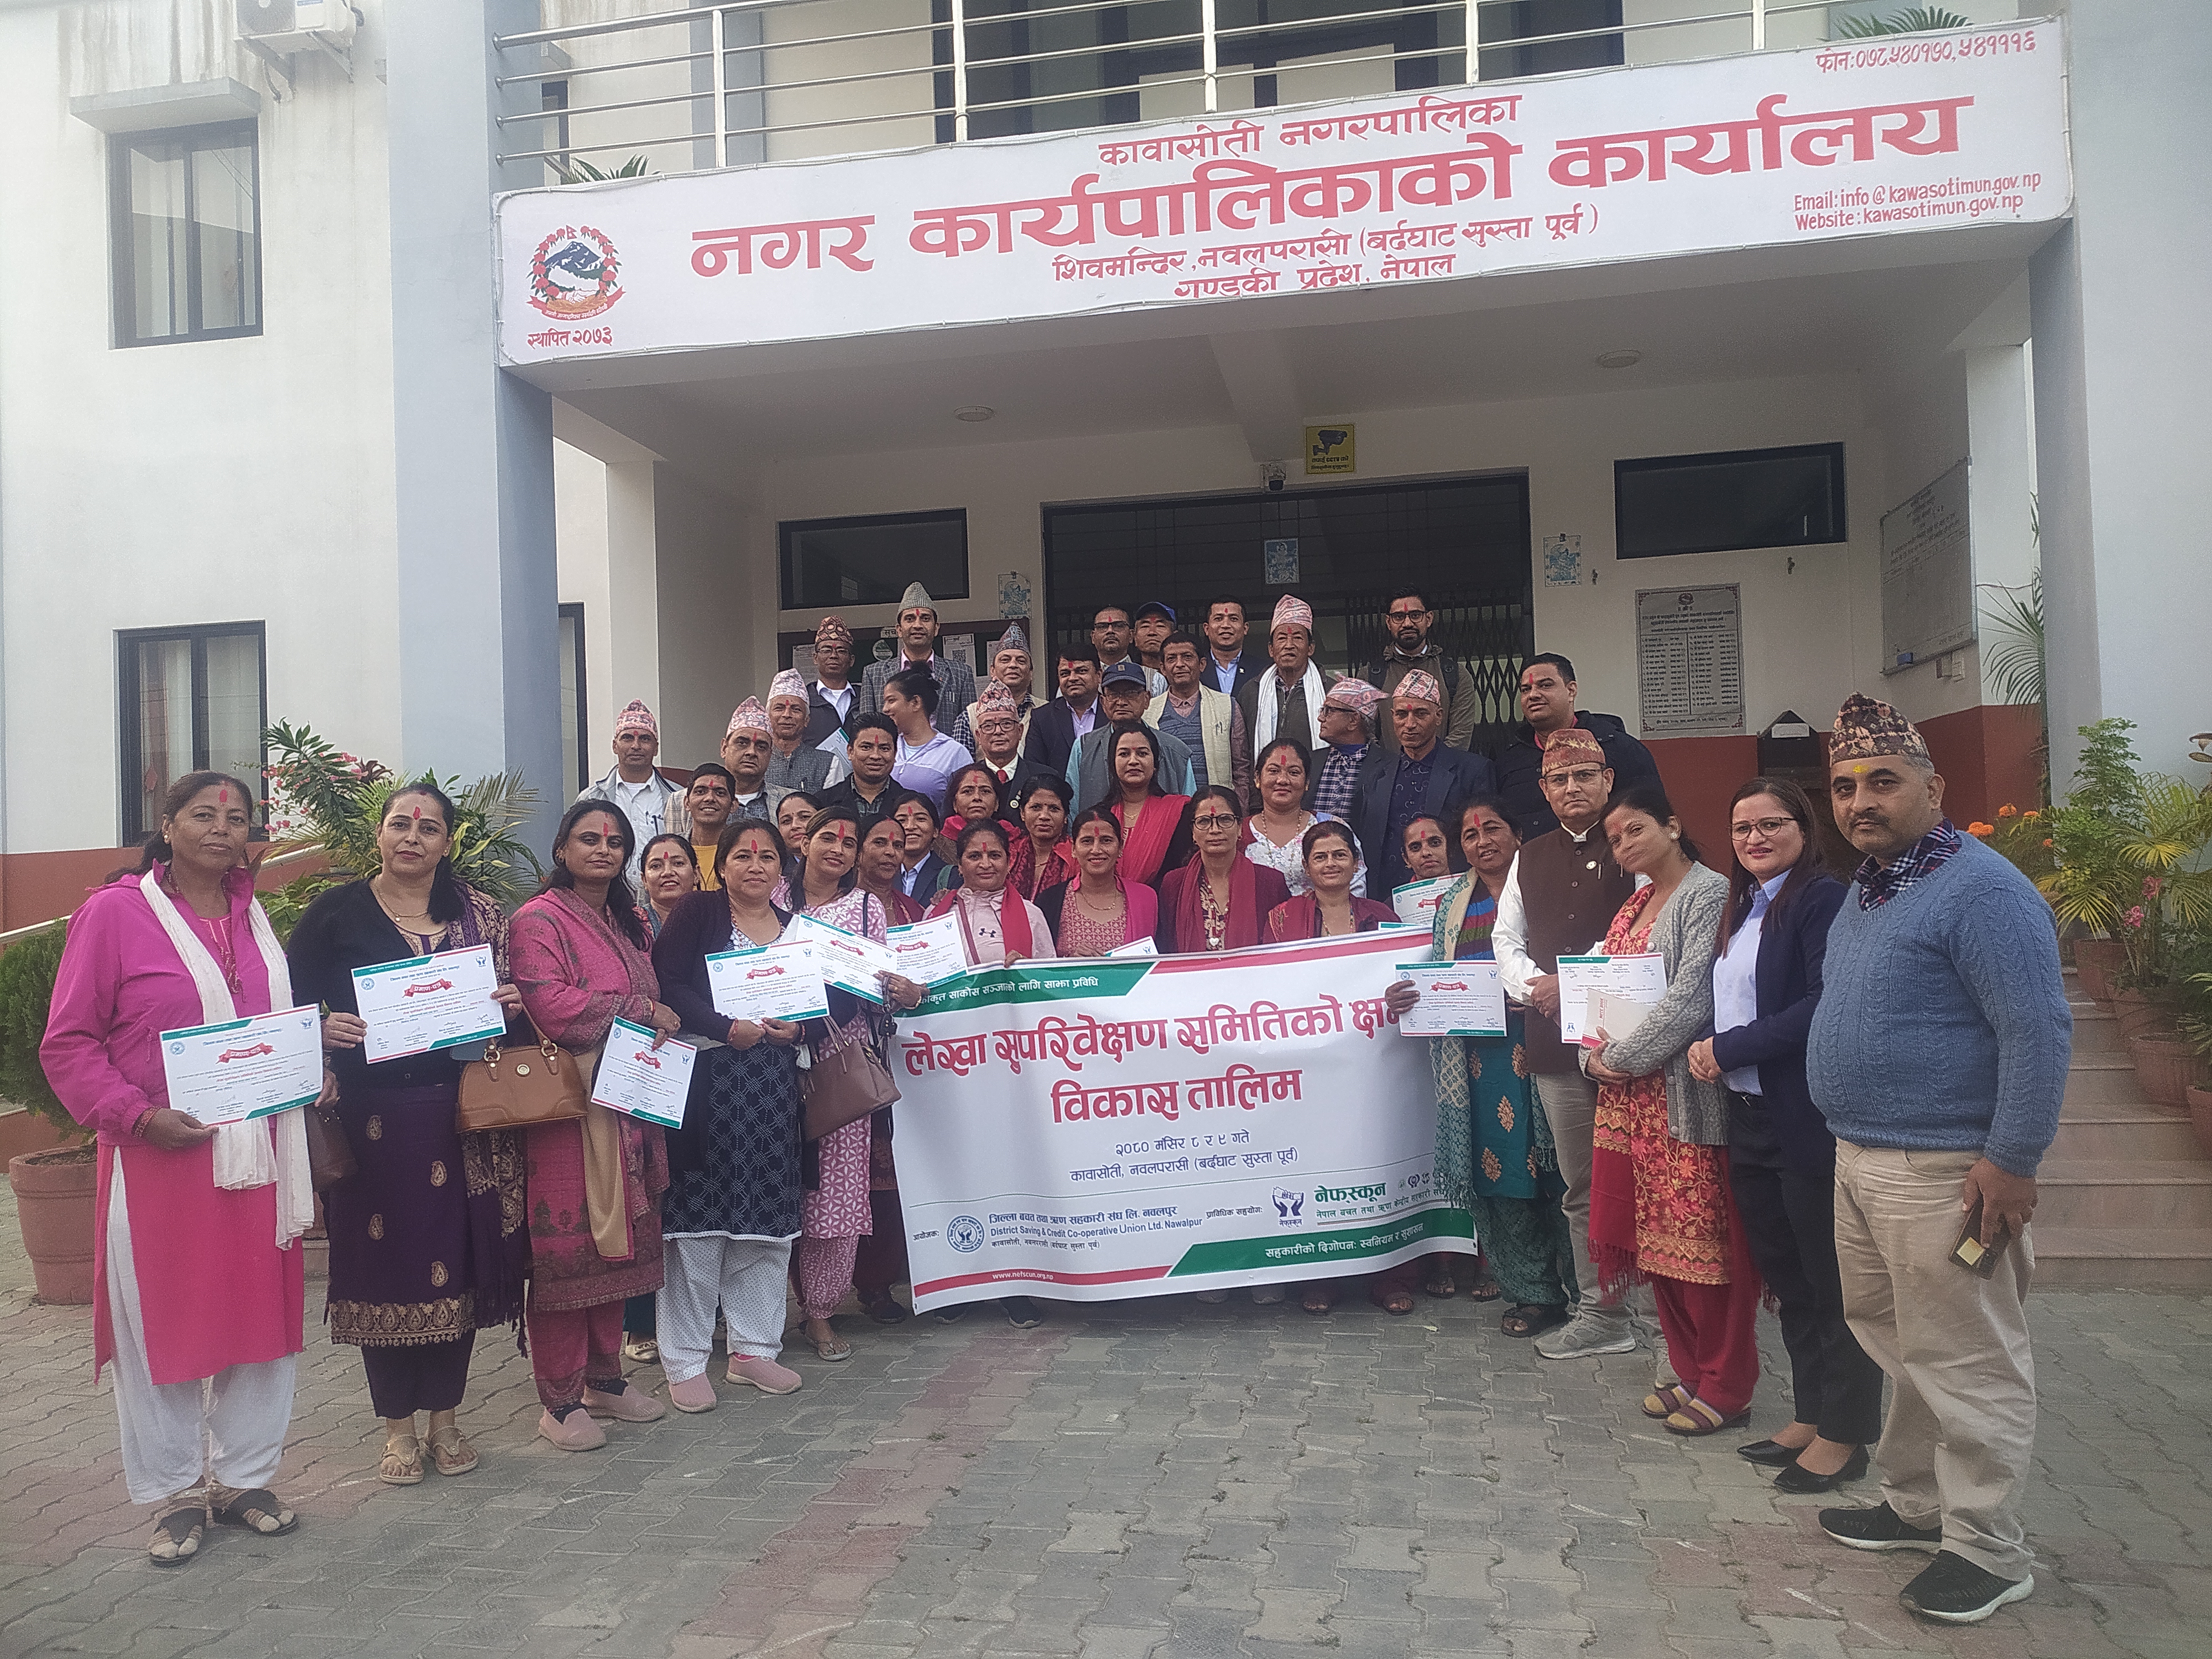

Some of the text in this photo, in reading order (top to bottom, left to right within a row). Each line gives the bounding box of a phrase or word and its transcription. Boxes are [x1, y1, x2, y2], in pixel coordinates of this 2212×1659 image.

[1099, 95, 1522, 165] कावासोती नगरपालिका
[691, 94, 1974, 278] नगर कार्यपालिकाको कार्यालय
[1840, 187, 1869, 207] info
[1359, 219, 1455, 256] (बर्दघाट
[1463, 217, 1532, 249] सुस्ता
[1174, 270, 1279, 300] गण्डकी
[1385, 254, 1454, 279] नेपाल
[528, 327, 612, 349] स्थापित २०७३
[948, 987, 980, 999] साकोस
[1018, 979, 1041, 991] लागि
[1044, 978, 1070, 989] साझा
[1072, 976, 1099, 989] प्रविधि
[902, 1030, 987, 1076] लेखा
[993, 1013, 1167, 1074] सुपरिवेक्षण
[1178, 993, 1343, 1055] समितिको
[1050, 1063, 1302, 1123] विकास तालिम
[1115, 1143, 1149, 1156] २०८०
[1154, 1136, 1186, 1151] मंसिर
[1191, 1136, 1199, 1147] ८
[1204, 1135, 1213, 1146] र
[1231, 1129, 1250, 1144] गते
[1070, 1147, 1298, 1181] कावासोती, नवलपरासी (बर्दघाट सुस्ता पूर्व)
[989, 1206, 1178, 1225] जिल्ला बचत तथा ऋण सहकारी संघ लि. नवलपुर
[1206, 1206, 1263, 1219] प्राविधिक सहयोग:
[1316, 1209, 1337, 1219] नेपाल
[1340, 1208, 1358, 1217] बचत
[1361, 1206, 1375, 1215] तथा
[1378, 1203, 1392, 1212] ऋण
[913, 1230, 940, 1241] आयोजक:
[990, 1226, 1018, 1236] District
[1020, 1227, 1041, 1237] Saving
[1047, 1227, 1066, 1238] Credit
[1067, 1227, 1118, 1239] Co-operative
[1119, 1223, 1146, 1234] Union
[1148, 1221, 1164, 1231] Ltd.
[1165, 1218, 1203, 1230] Nawalpur
[1265, 1243, 1316, 1259] सहकारीको
[1318, 1239, 1357, 1255] दिगोपन:
[1360, 1235, 1394, 1248] स्वनियम
[1401, 1223, 1424, 1240] सुशासन
